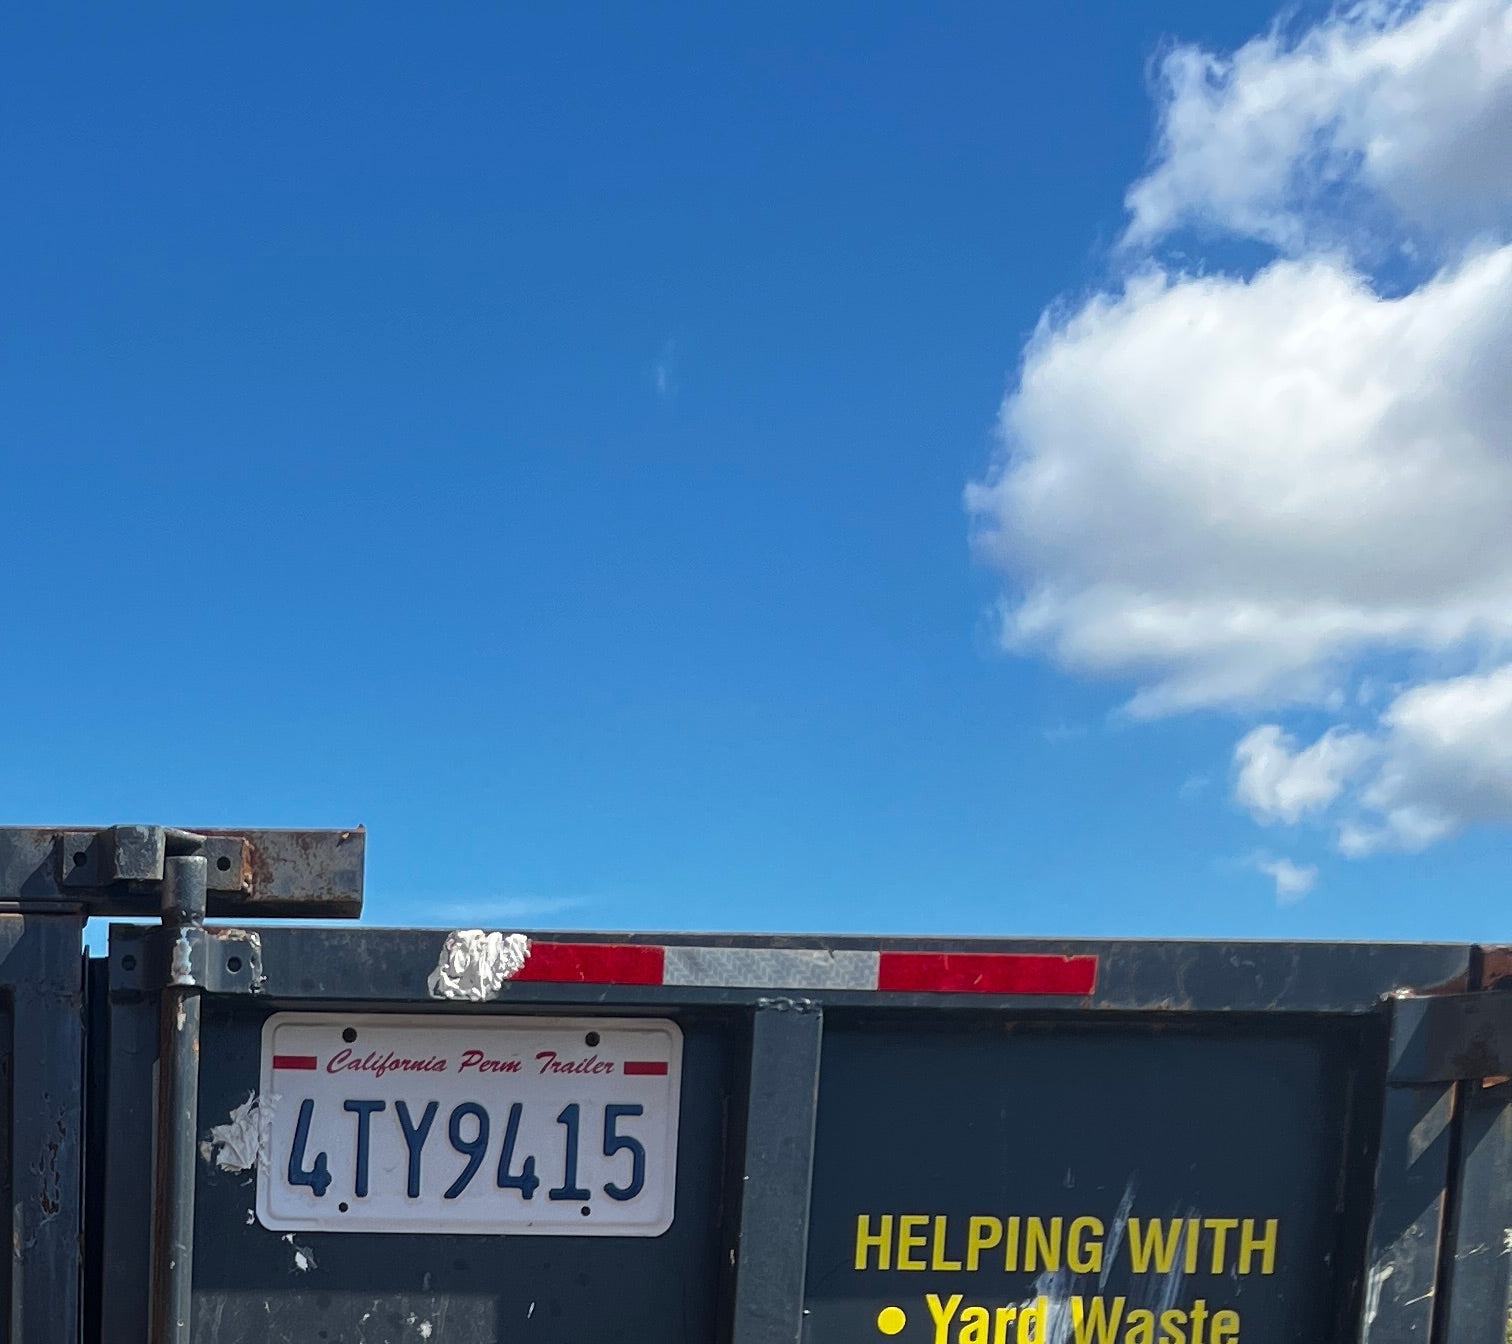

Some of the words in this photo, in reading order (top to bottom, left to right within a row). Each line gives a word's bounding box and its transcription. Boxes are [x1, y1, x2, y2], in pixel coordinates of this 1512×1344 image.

[326, 1047, 446, 1075] California
[457, 1049, 522, 1074] Perm
[536, 1051, 615, 1076] Trailer
[288, 1098, 645, 1201] 4TY9415
[854, 1215, 1104, 1274] HELPING
[1128, 1219, 1278, 1274] WITH
